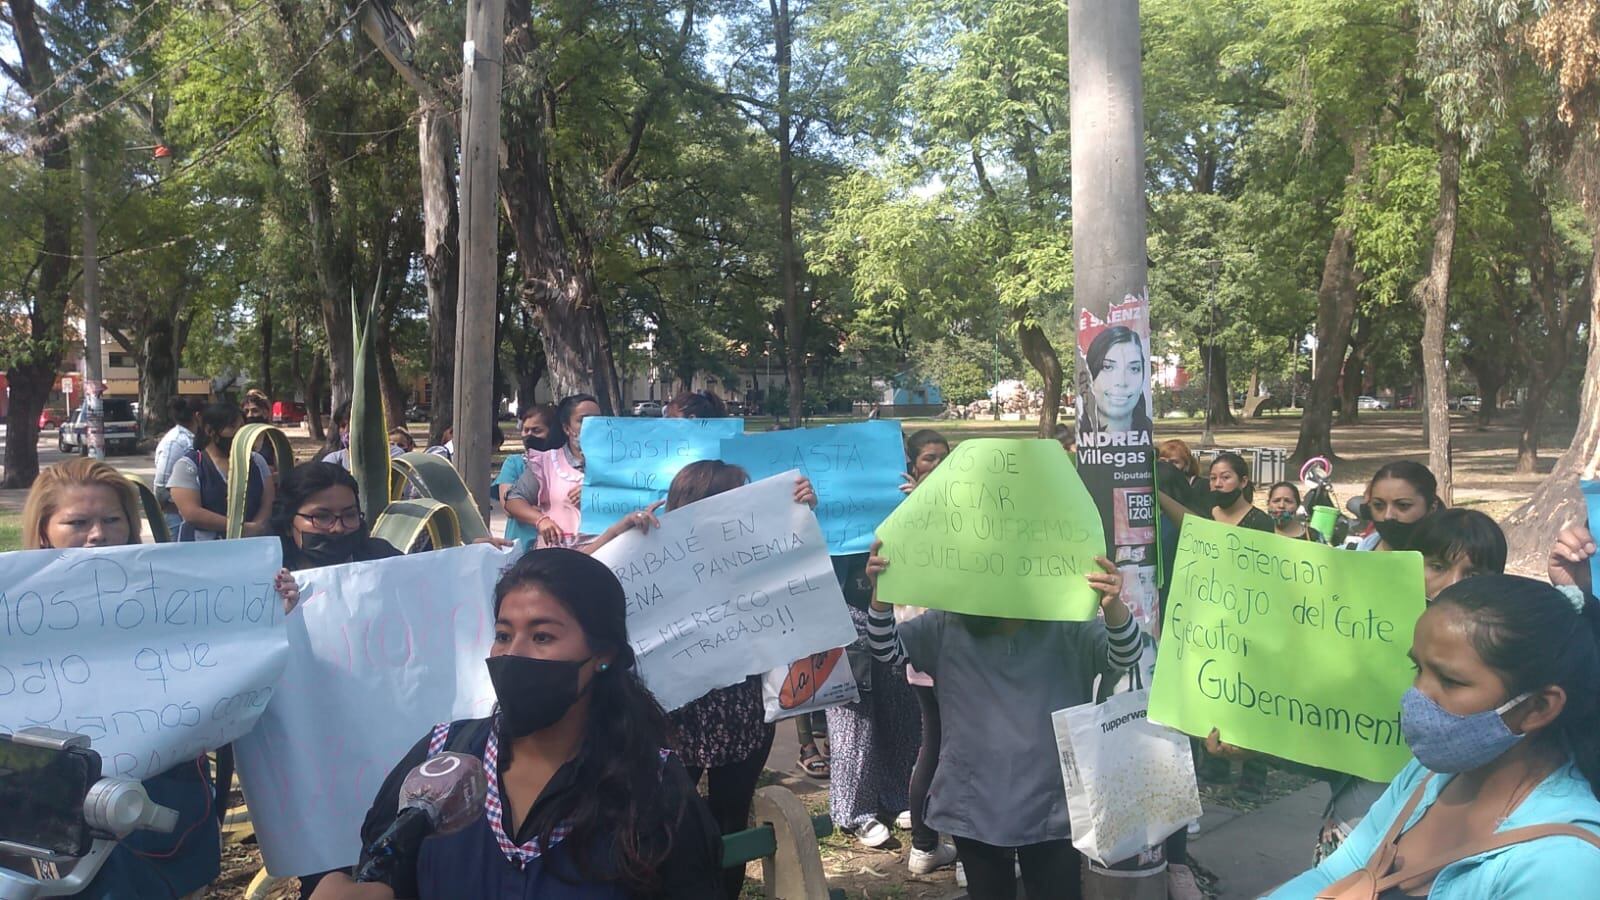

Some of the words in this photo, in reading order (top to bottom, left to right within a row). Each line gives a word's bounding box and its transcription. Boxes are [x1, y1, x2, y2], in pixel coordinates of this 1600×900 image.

[768, 443, 865, 476] ASTA
[987, 448, 1020, 474] DE
[1079, 448, 1146, 467] Villegas
[721, 512, 756, 543] EN
[692, 532, 805, 584] PANDEMIA
[1225, 532, 1330, 586] Potenciar
[787, 574, 821, 596] EL
[1292, 596, 1325, 631] del
[1171, 602, 1252, 661] Ejecutor
[134, 641, 218, 694] que
[1197, 658, 1408, 747] Gubernament
